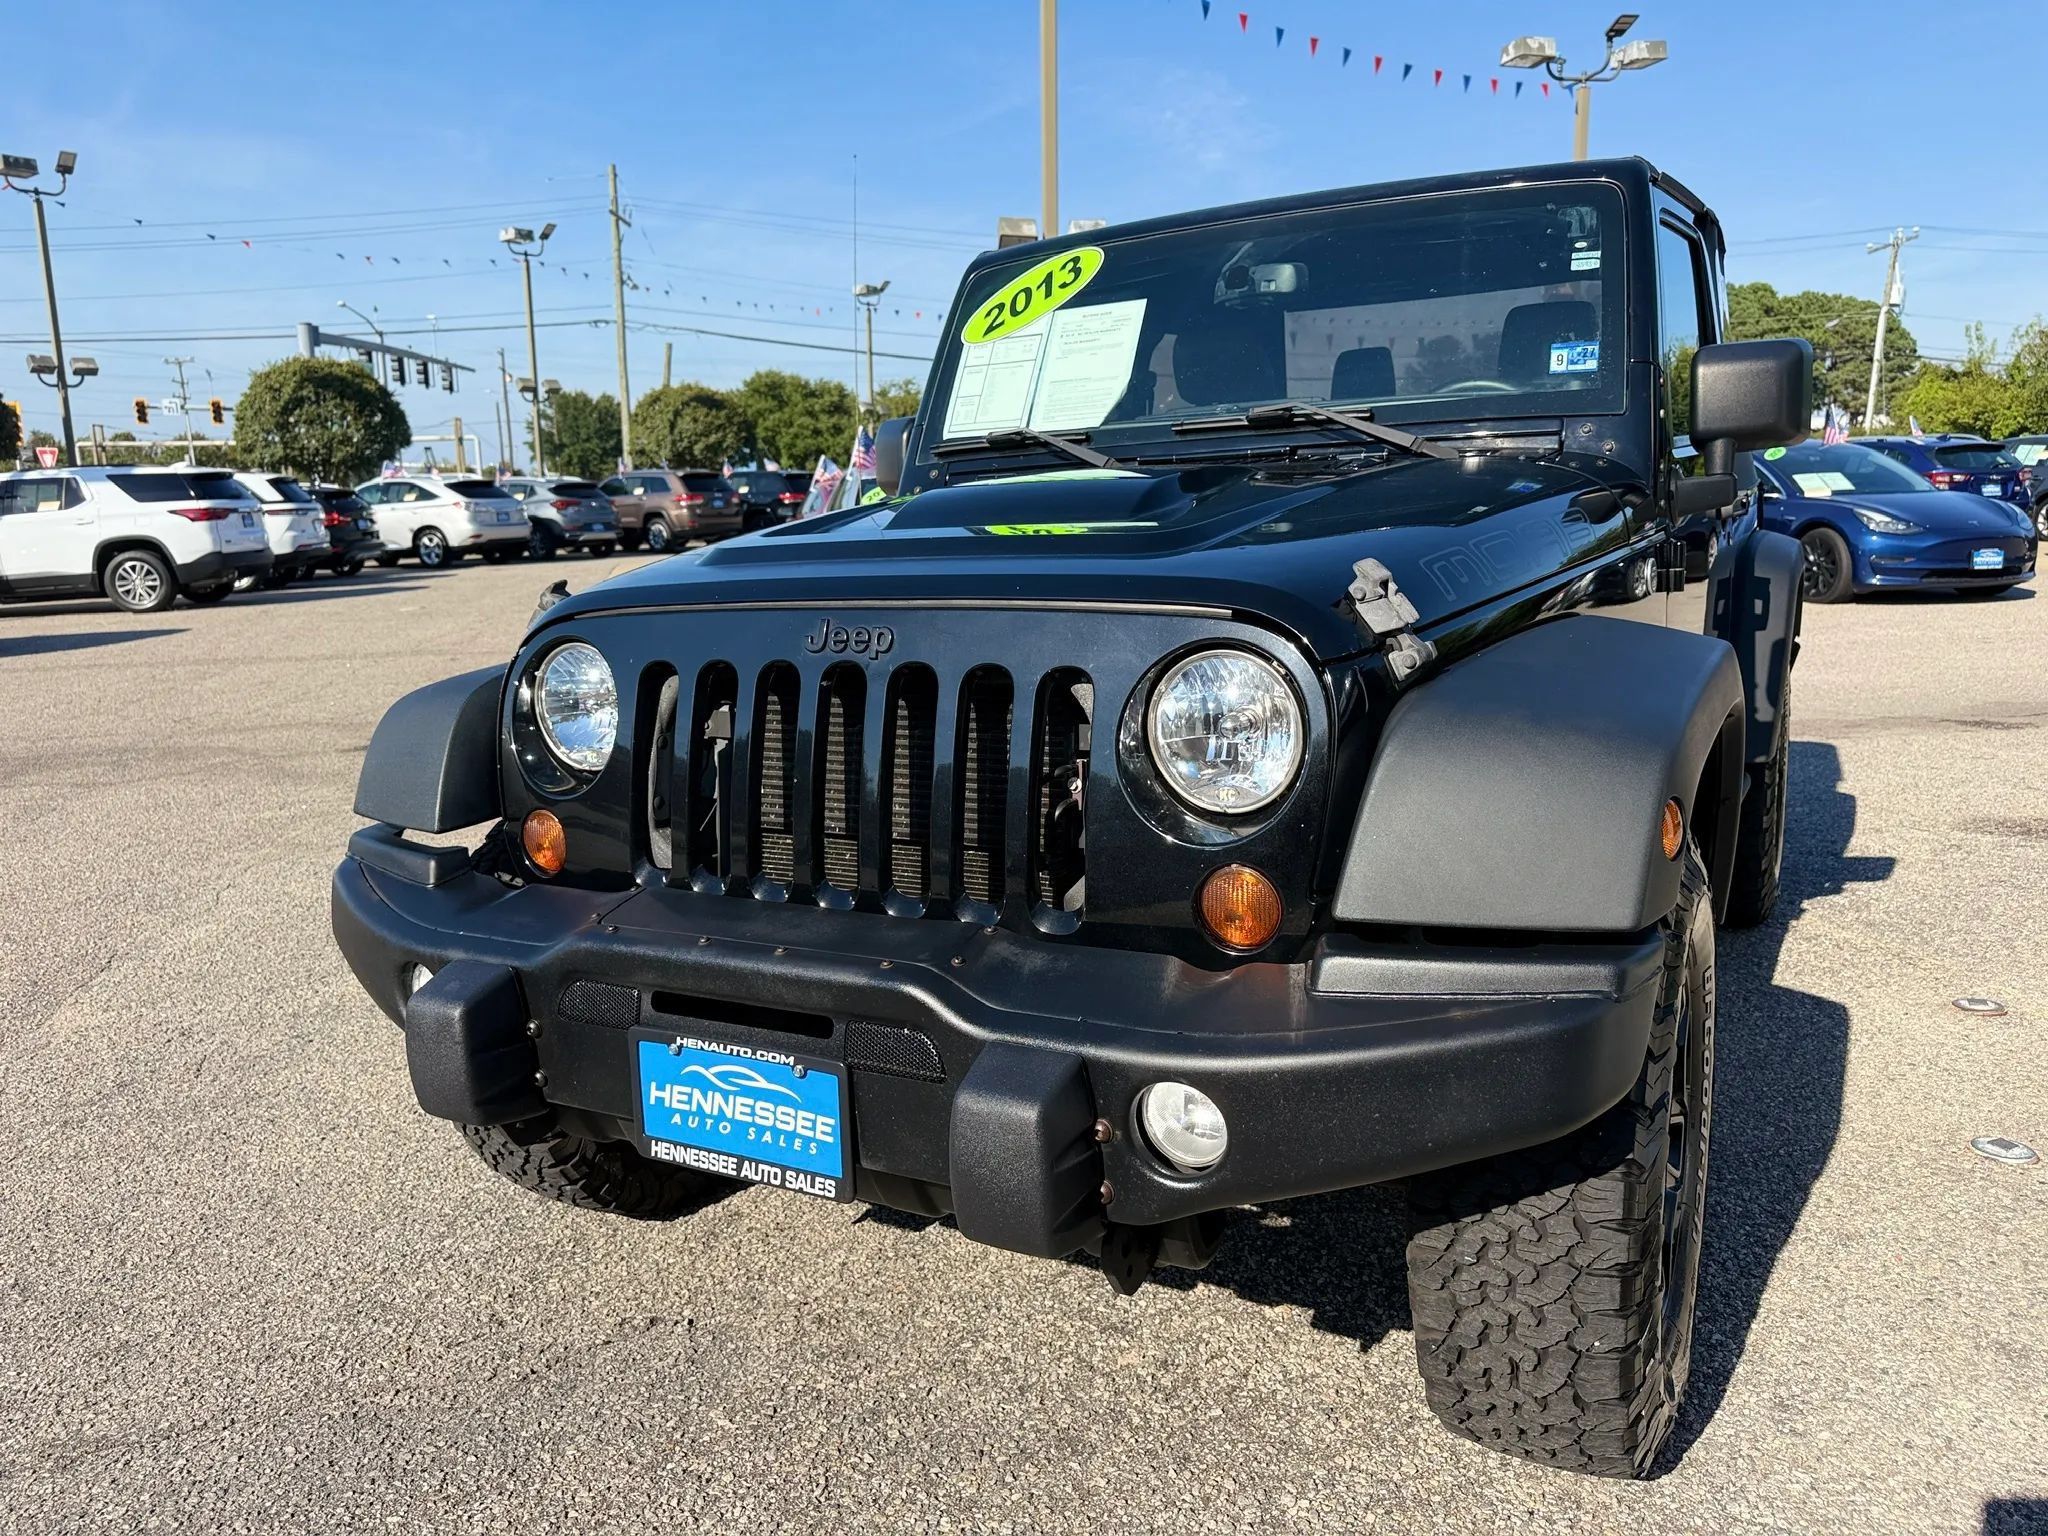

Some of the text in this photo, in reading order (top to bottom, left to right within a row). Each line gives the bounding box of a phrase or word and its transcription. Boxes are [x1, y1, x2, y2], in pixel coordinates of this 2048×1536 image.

[982, 255, 1083, 339] 2013
[1556, 353, 1564, 366] 9
[804, 618, 895, 660] Jeep
[1219, 788, 1236, 801] KC
[676, 1036, 795, 1066] HENAUTO.COM
[649, 1081, 836, 1143] HENNESSEE
[670, 1113, 818, 1155] AUTO SALES
[650, 1139, 836, 1198] HENNESSEE AUTO SALES
